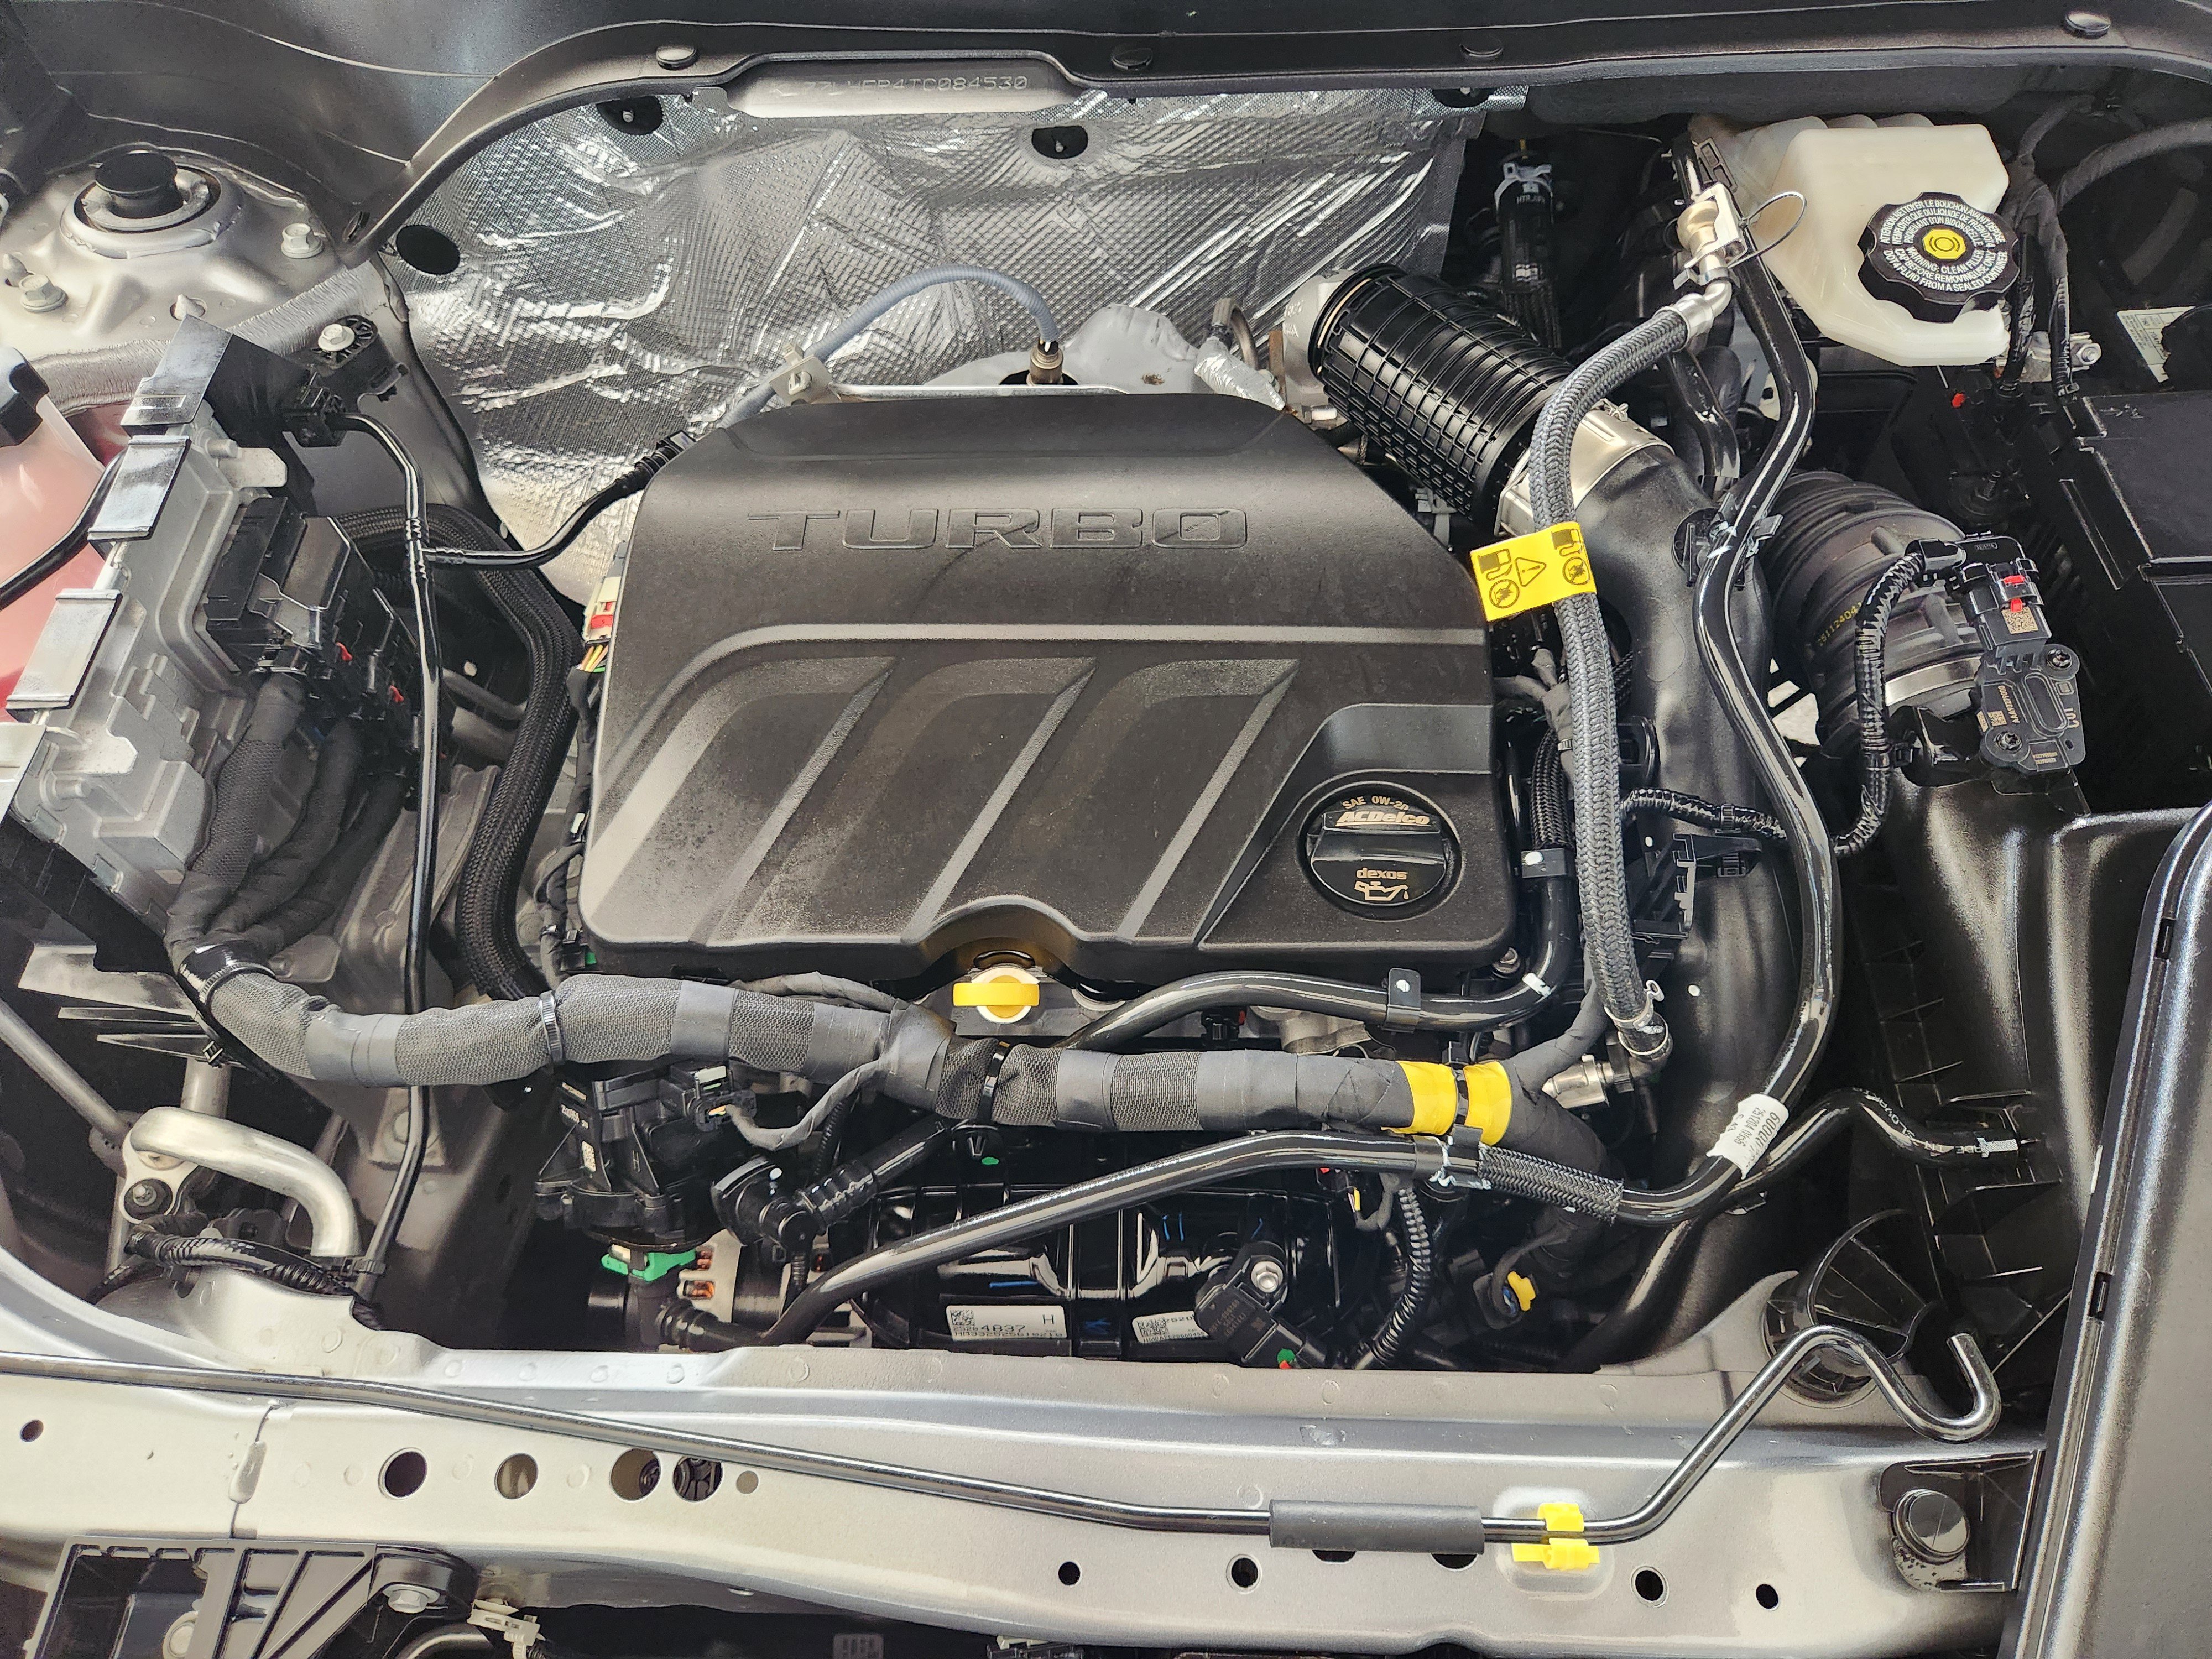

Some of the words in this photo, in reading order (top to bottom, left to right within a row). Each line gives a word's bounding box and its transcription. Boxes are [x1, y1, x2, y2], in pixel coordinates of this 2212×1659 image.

[1890, 200, 1925, 218] NETTOYER
[1923, 199, 1934, 207] LE
[1934, 200, 1969, 214] BOUCHON
[1966, 207, 1991, 225] AVANT
[1984, 222, 2007, 243] DEPOSE
[1904, 217, 1930, 243] PROVENANT
[1944, 217, 1966, 229] BIDON
[1961, 225, 1984, 247] SCELLE
[1908, 210, 1924, 220] QUE
[1933, 208, 1960, 219] LIQUIDE
[1958, 213, 1971, 223] DE
[1966, 218, 1988, 234] FREIN
[1894, 248, 1912, 263] CAP
[1904, 259, 1935, 280] BEFORE
[1973, 264, 1990, 276] USE
[1940, 264, 1970, 274] CLEAN
[1964, 249, 1983, 269] FILLER
[1895, 264, 1921, 283] FLUID
[1918, 277, 1944, 291] FROM
[1952, 279, 1986, 291] SEALED
[748, 507, 1248, 552] TURBO
[1342, 796, 1366, 810] SAE
[1371, 795, 1409, 810] 0W-20
[1336, 811, 1431, 826] ACDelco
[1356, 867, 1408, 880] dexos
[980, 1324, 1026, 1333] 4837
[1042, 1314, 1055, 1325] H
